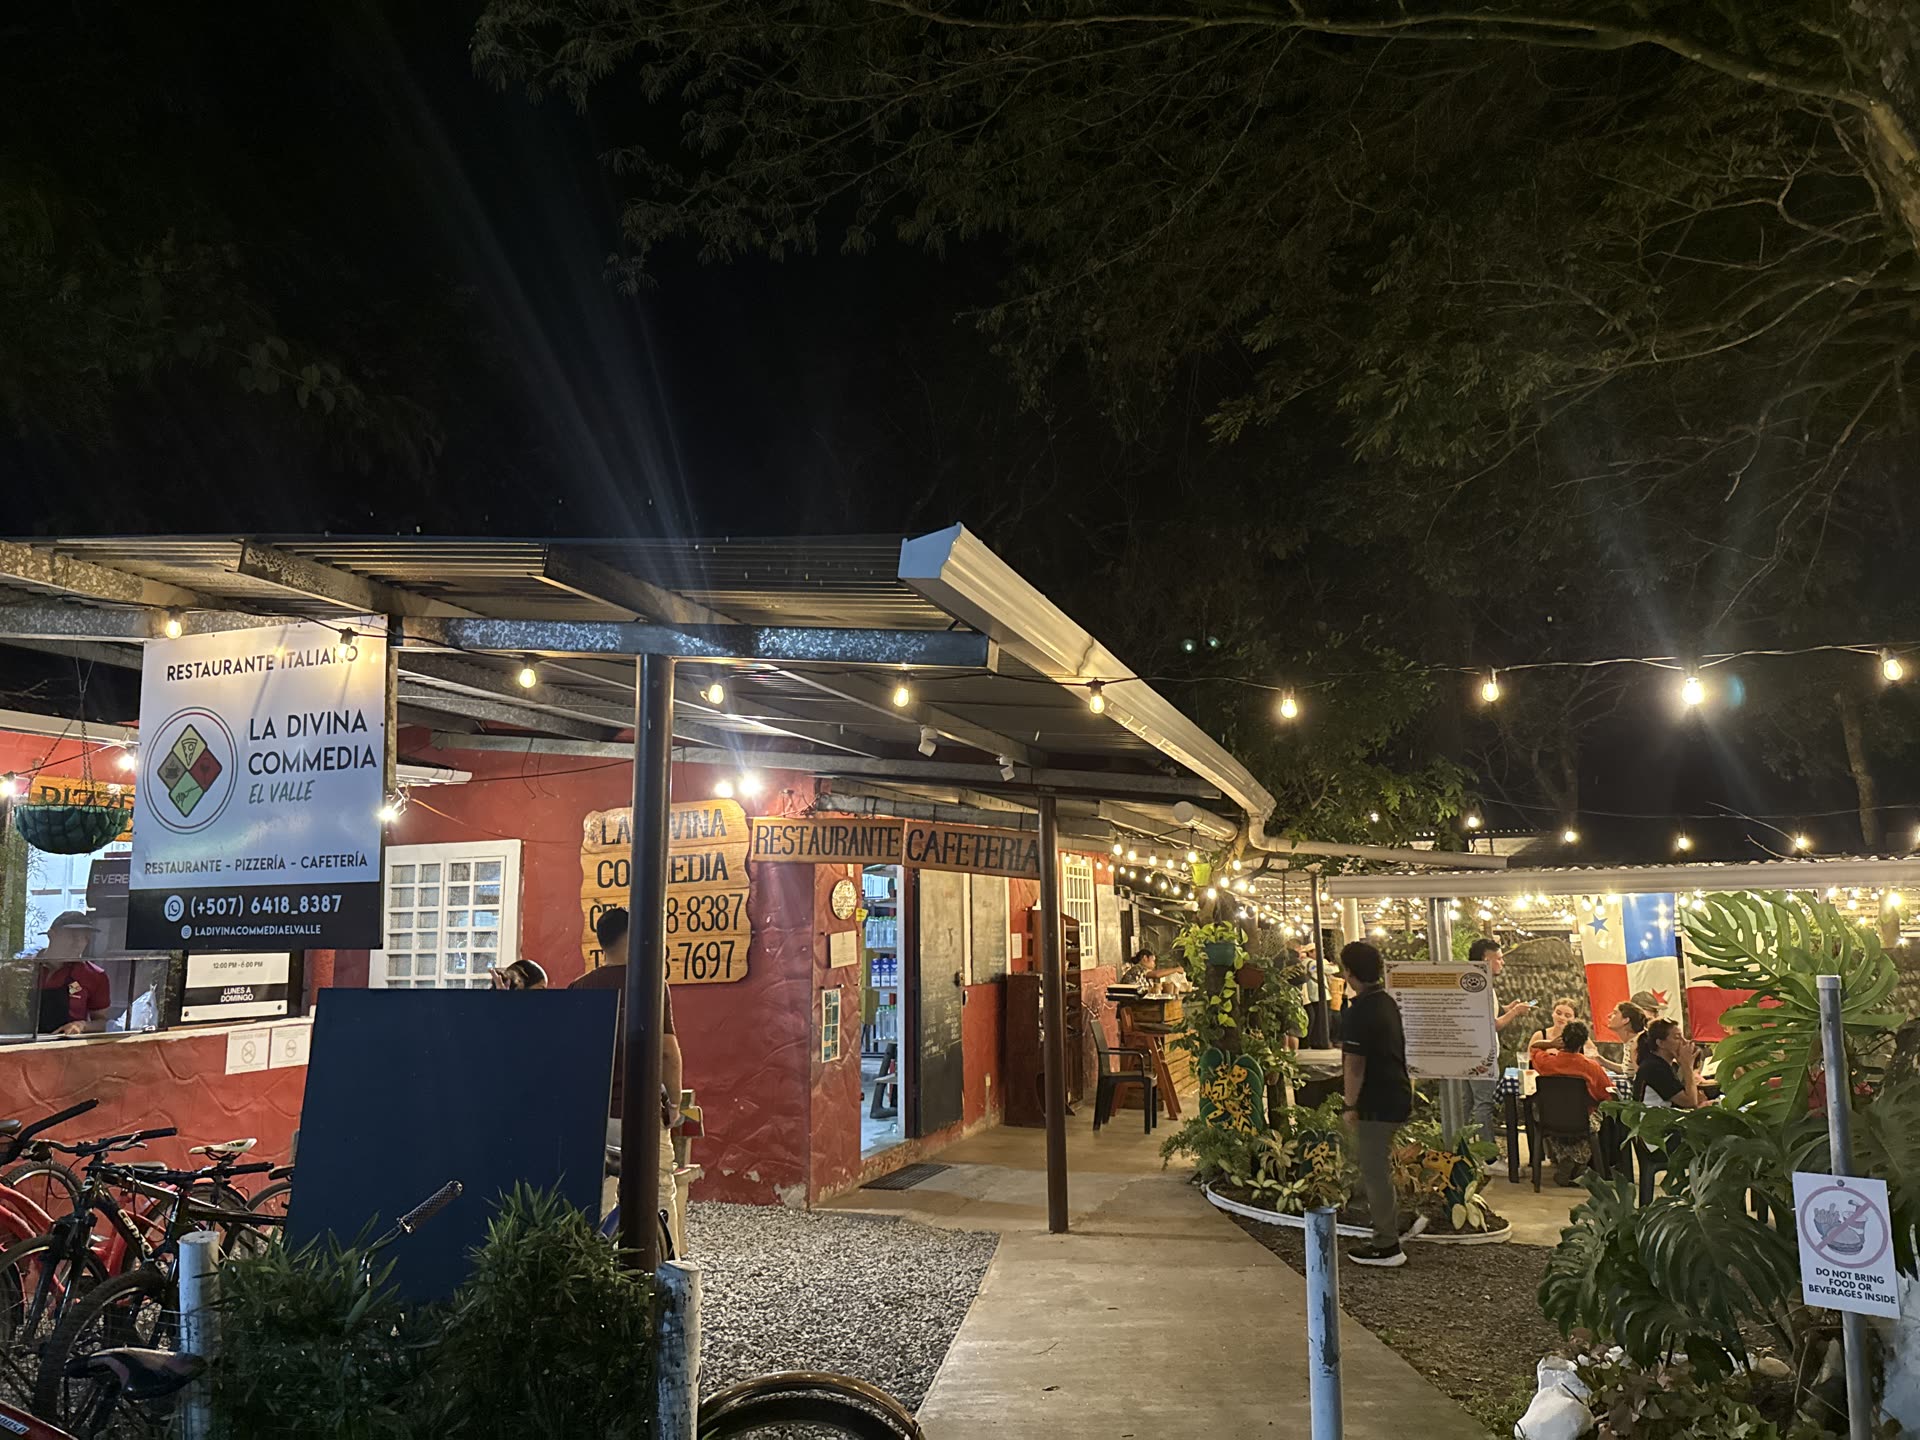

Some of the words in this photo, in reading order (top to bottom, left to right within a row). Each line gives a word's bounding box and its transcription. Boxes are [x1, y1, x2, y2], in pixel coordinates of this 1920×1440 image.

[166, 655, 274, 682] RESTAURANTE
[250, 716, 277, 741] LA
[287, 709, 368, 738] DIVINA
[248, 744, 377, 776] COMMEDIA
[249, 783, 264, 804] EL
[270, 780, 316, 802] VALLE
[670, 808, 727, 840] VINA
[754, 825, 900, 858] RESTAURANTE
[906, 828, 1040, 874] CAFETERIA
[144, 860, 222, 875] RESTAURANTE
[234, 854, 286, 872] PIZZERÍA
[300, 850, 368, 869] CAFETERÍA
[597, 852, 729, 889] COEDIA
[190, 895, 244, 918] (+507)
[250, 894, 342, 915] 6418_8387
[194, 924, 321, 937] LADIVINACOMMEDIAELVALLE
[220, 994, 254, 1003] DOMINGO
[224, 987, 246, 995] LUNES
[246, 986, 251, 994] A
[1816, 1268, 1830, 1276] DO
[1832, 1270, 1852, 1280] NOT
[1854, 1273, 1885, 1284] BRING
[1829, 1278, 1856, 1289] FOOD
[1858, 1282, 1872, 1292] OR
[1808, 1284, 1863, 1299] BEVERAGES
[1864, 1292, 1896, 1304] INSIDE
